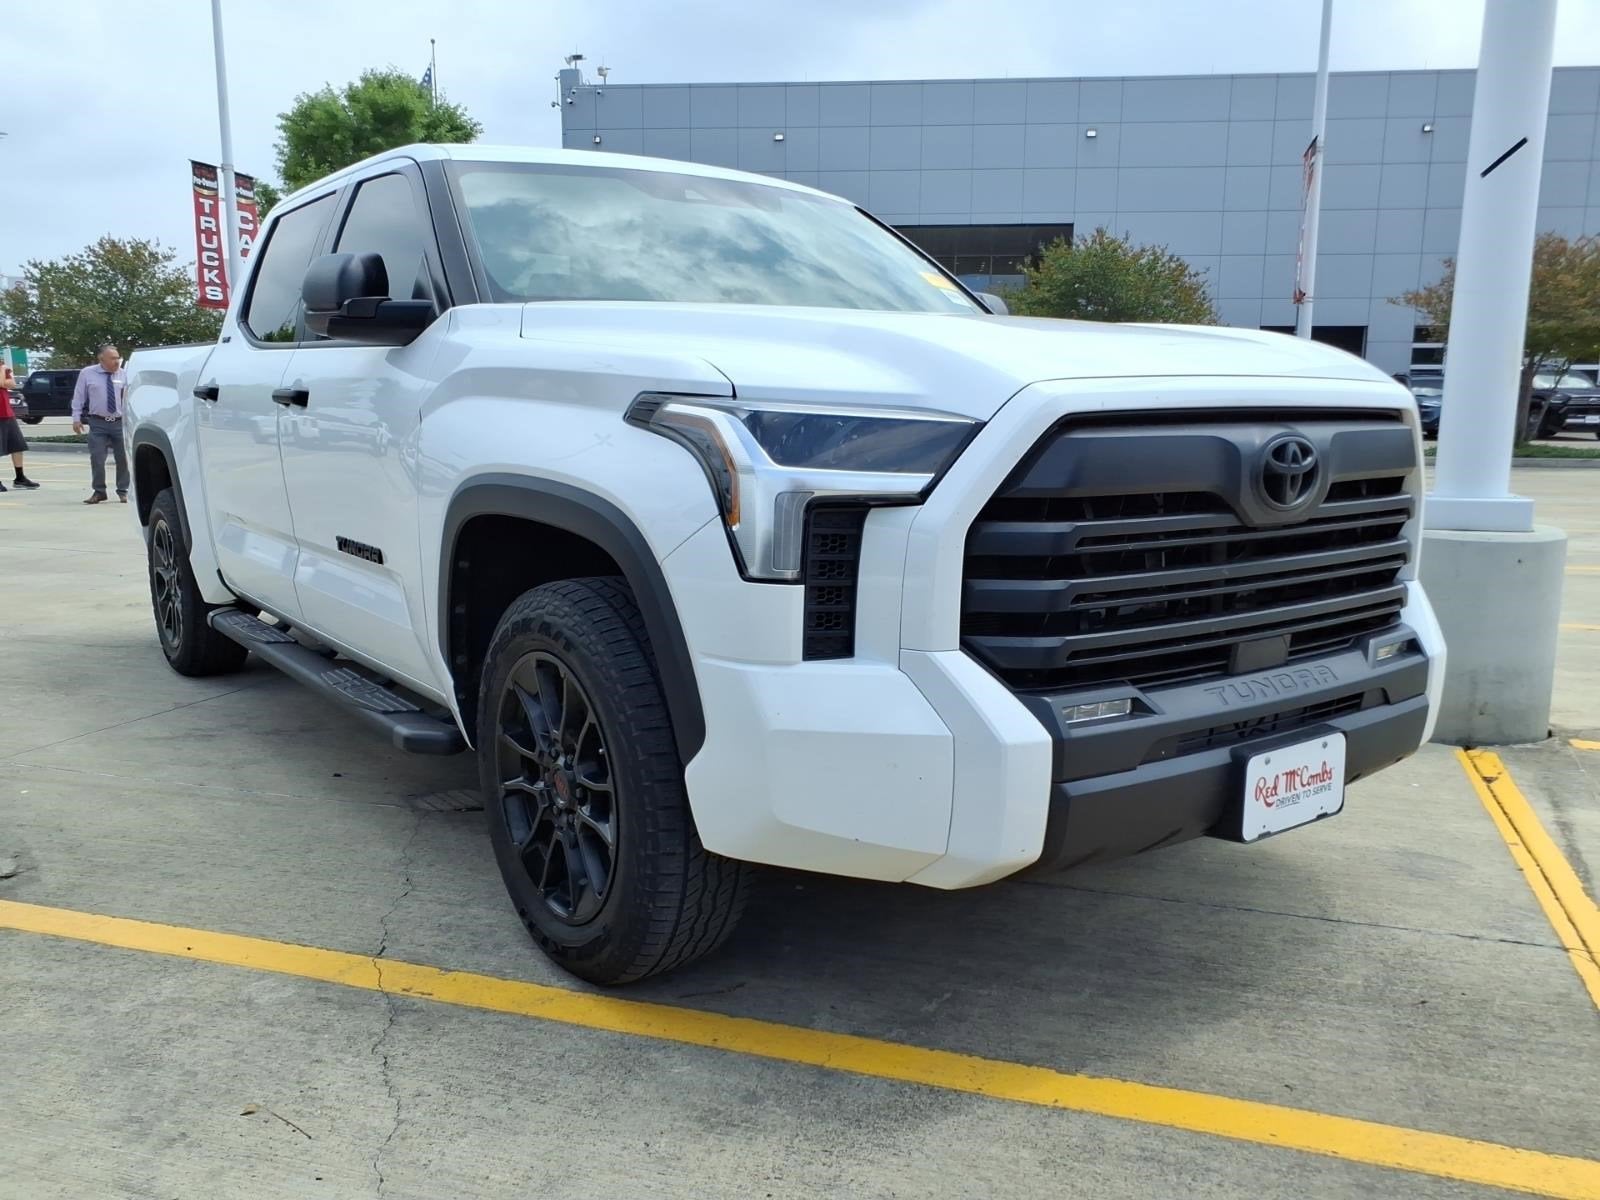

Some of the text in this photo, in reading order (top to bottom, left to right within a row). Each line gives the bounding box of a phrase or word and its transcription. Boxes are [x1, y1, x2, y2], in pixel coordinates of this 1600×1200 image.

[199, 197, 224, 301] TRUCKS
[336, 535, 384, 565] TUNDRA
[1203, 664, 1339, 706] TUNDRA
[1255, 774, 1279, 808] Red
[1275, 783, 1332, 808] DRIVEN TO SERVE
